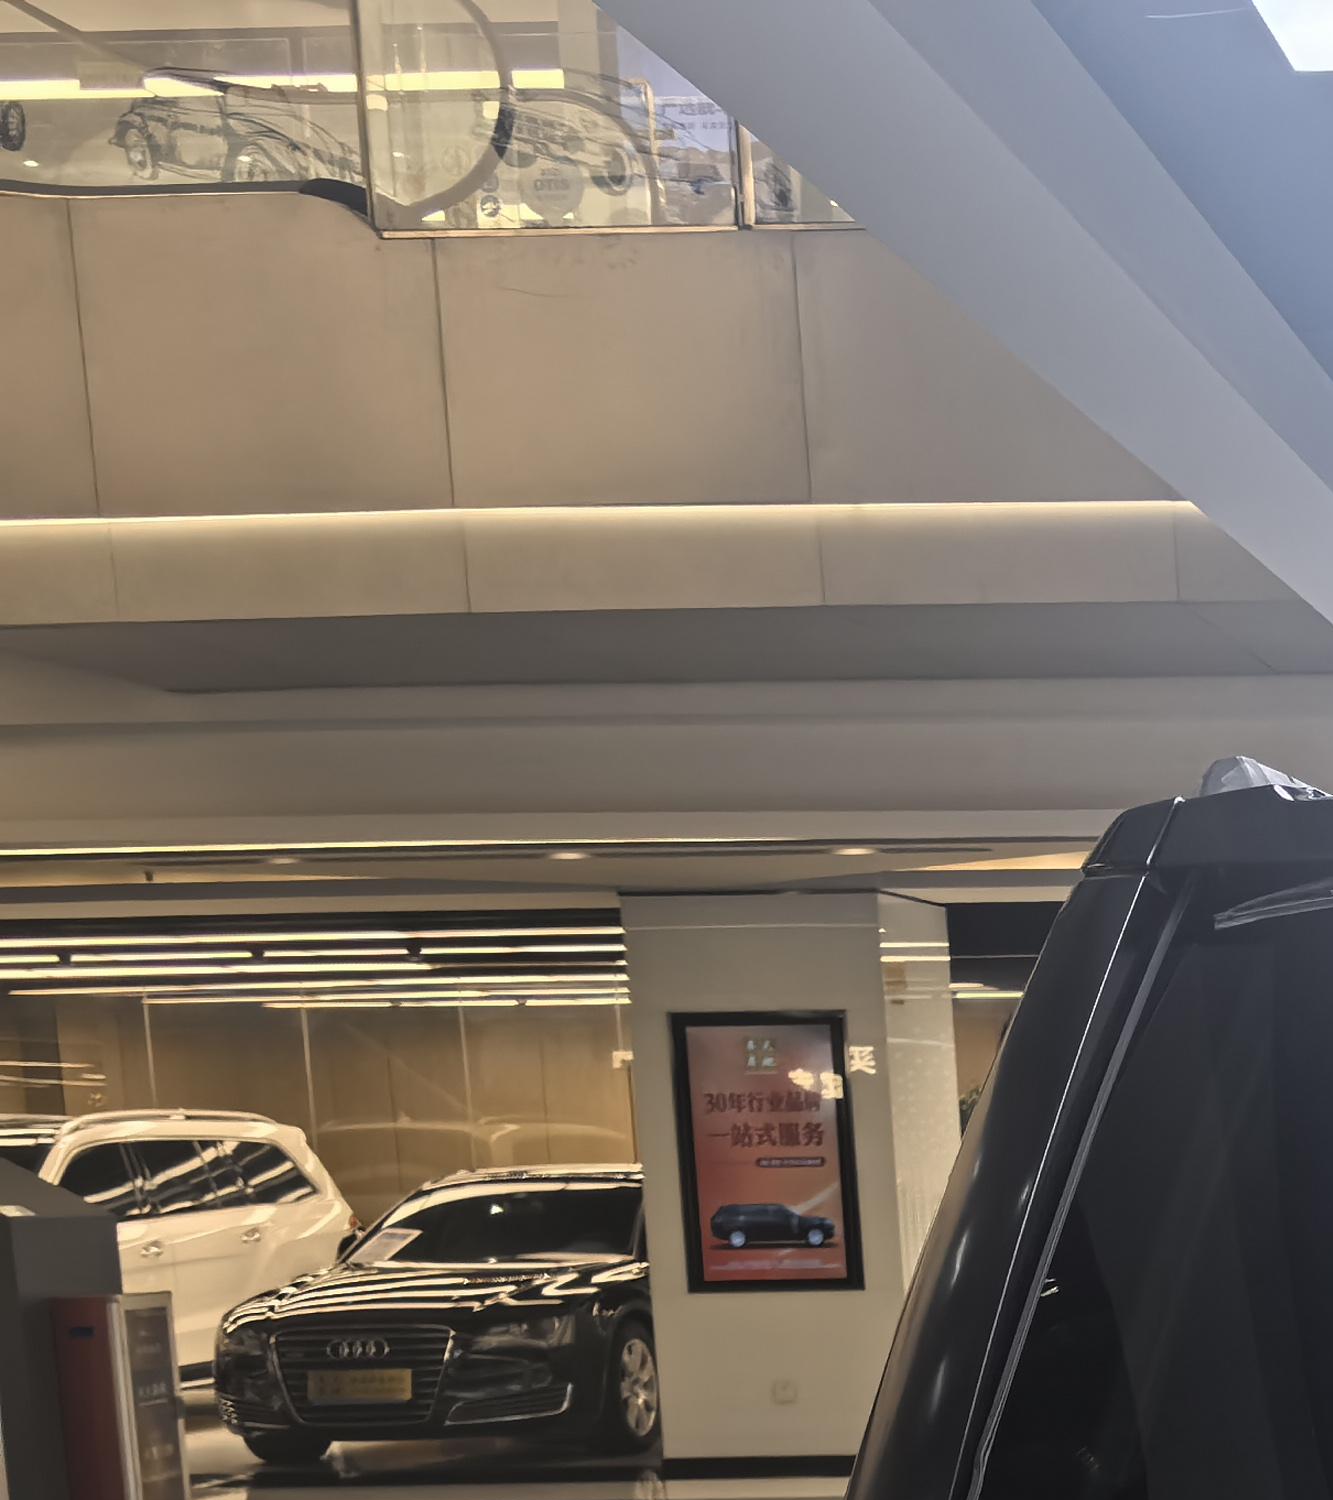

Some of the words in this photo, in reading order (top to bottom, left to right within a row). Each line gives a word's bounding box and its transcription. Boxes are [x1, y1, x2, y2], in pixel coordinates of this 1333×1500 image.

[706, 1121, 826, 1149] 一站式服务
